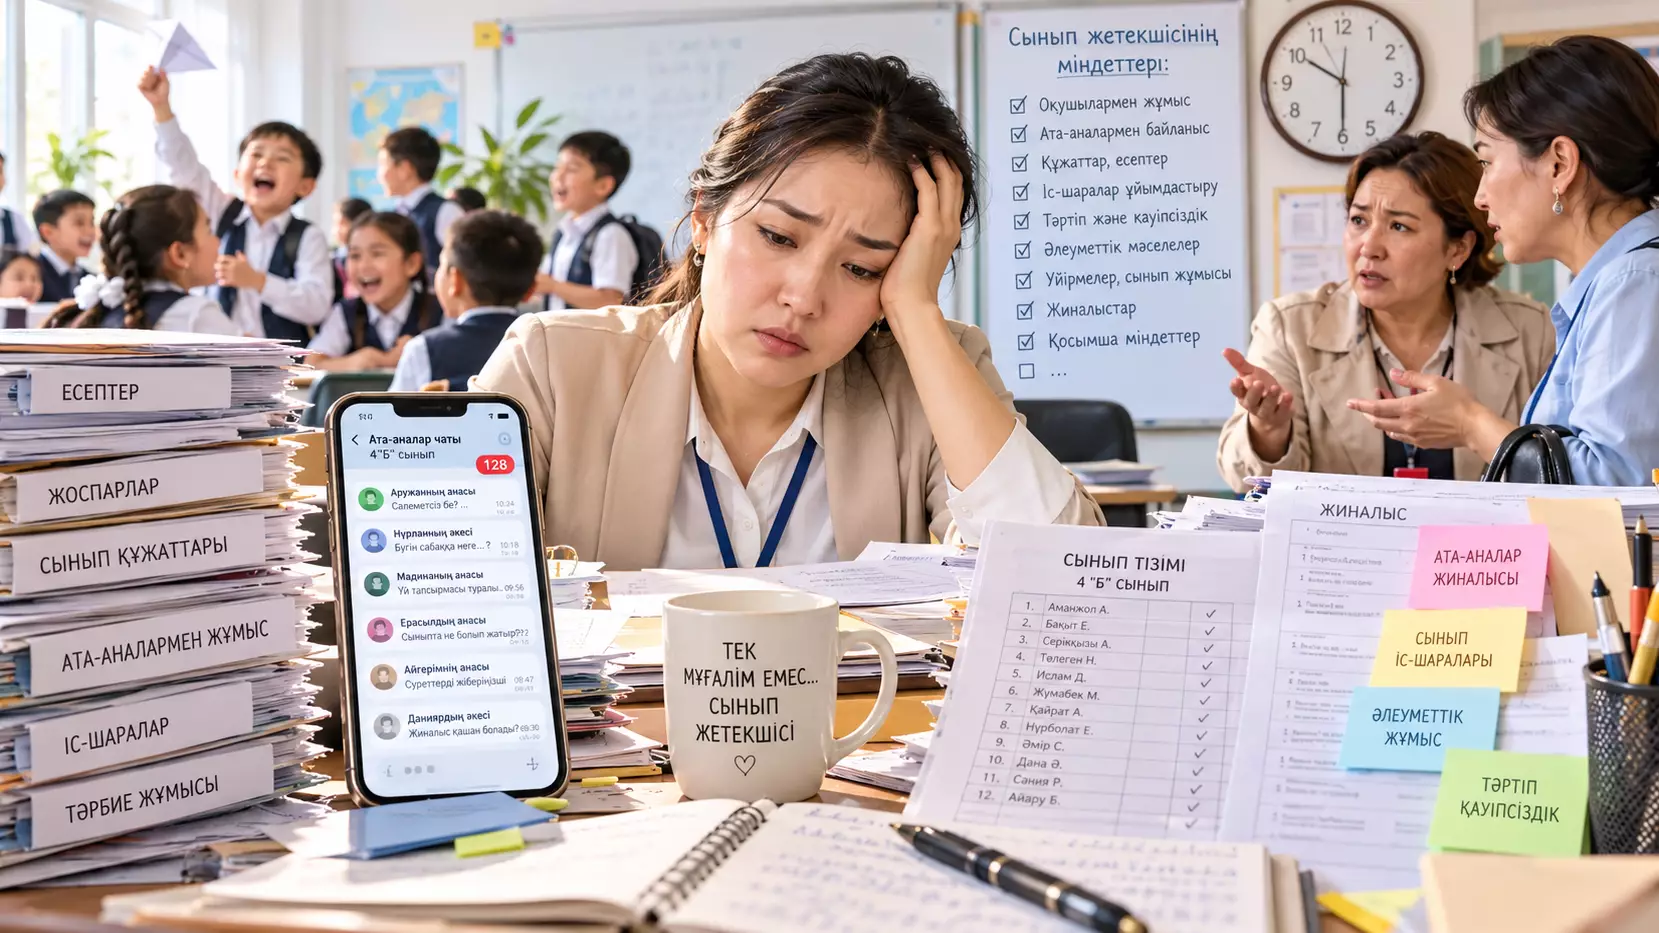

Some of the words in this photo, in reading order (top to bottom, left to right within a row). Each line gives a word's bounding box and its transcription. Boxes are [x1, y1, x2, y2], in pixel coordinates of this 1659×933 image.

[1008, 26, 1077, 46] Сынып
[1087, 23, 1219, 46] жетекшісінің
[1309, 27, 1323, 43] 11
[1334, 18, 1352, 35] 12
[1367, 26, 1374, 42] 1
[1289, 47, 1306, 64] 10
[1385, 44, 1396, 61] 2
[1057, 54, 1169, 78] міндеттері:
[1281, 75, 1293, 91] 9
[1393, 72, 1404, 89] 3
[1038, 97, 1138, 115] Оқушылармен
[1143, 95, 1191, 112] жұмыс
[1289, 102, 1301, 118] 8
[1384, 100, 1396, 116] 4
[1039, 124, 1140, 142] Ата-аналармен
[1146, 121, 1210, 137] байланыс
[1311, 121, 1322, 137] 7
[1337, 128, 1349, 144] 6
[1365, 120, 1376, 137] 5
[1041, 154, 1110, 173] Құжаттар,
[1115, 153, 1169, 170] есептер
[1125, 180, 1219, 200] ұйымдастыру
[1043, 211, 1086, 231] Тәртіп
[1093, 213, 1127, 226] және
[1044, 239, 1122, 260] Әлеуметтік
[1128, 240, 1200, 256] мәселелер
[1124, 270, 1169, 284] сынып
[1174, 268, 1232, 286] жұмысы
[1046, 301, 1137, 320] Жиналыстар
[1048, 332, 1119, 352] Қосымша
[1125, 329, 1201, 349] міндеттер
[61, 383, 140, 401] ЕСЕПТЕР
[369, 434, 432, 446] Ата-аналар
[434, 434, 461, 445] чаты
[398, 450, 435, 460] сынып
[483, 459, 508, 471] 128
[48, 477, 160, 506] ЖОСПАРЛАР
[390, 487, 446, 499] Аружанның
[447, 487, 476, 497] анасы
[443, 500, 459, 510] бе?
[1319, 502, 1408, 522] ЖИНАЛЫС
[39, 549, 111, 575] СЫНЫП
[117, 535, 229, 569] ҚҰЖАТТАРЫ
[1063, 552, 1129, 571] СЫНЫП
[1134, 554, 1186, 572] ТІЗІМІ
[1433, 548, 1522, 565] АТА-АНАЛАР
[396, 571, 454, 583] Мадинаның
[455, 570, 484, 580] анасы
[1076, 576, 1086, 588] 4
[1433, 571, 1519, 587] ЖИНАЛЫСЫ
[411, 584, 466, 597] тапсырмасы
[400, 617, 456, 629] Ерасылдың
[457, 616, 487, 626] анасы
[1045, 619, 1078, 631] Бақыт
[401, 632, 443, 643] Сыныпта
[444, 631, 455, 641] не
[1415, 630, 1468, 646] СЫНЫП
[61, 629, 203, 673] АТА-АНАЛАРМЕН
[207, 619, 270, 648] ЖҰМЫС
[722, 642, 757, 660] ТЕК
[404, 662, 459, 675] Айгерімнің
[459, 662, 490, 673] анасы
[1036, 669, 1073, 682] Ислам
[404, 678, 455, 690] Суреттерді
[763, 667, 819, 688] ЕМЕС...
[709, 696, 779, 715] СЫНЫП
[407, 712, 465, 726] Даниярдың
[466, 710, 491, 721] әкесі
[1371, 707, 1464, 725] ӘЛЕУМЕТТІК
[64, 716, 170, 755] ІС-ШАРАЛАР
[409, 727, 451, 740] Жиналыс
[452, 726, 481, 738] қашан
[1384, 731, 1442, 748] ЖҰМЫС
[1016, 755, 1048, 770] Дана
[1482, 776, 1538, 796] ТӘРТІП
[65, 792, 133, 824] ТӘРБИЕ
[139, 774, 220, 810] ЖҰМЫСЫ
